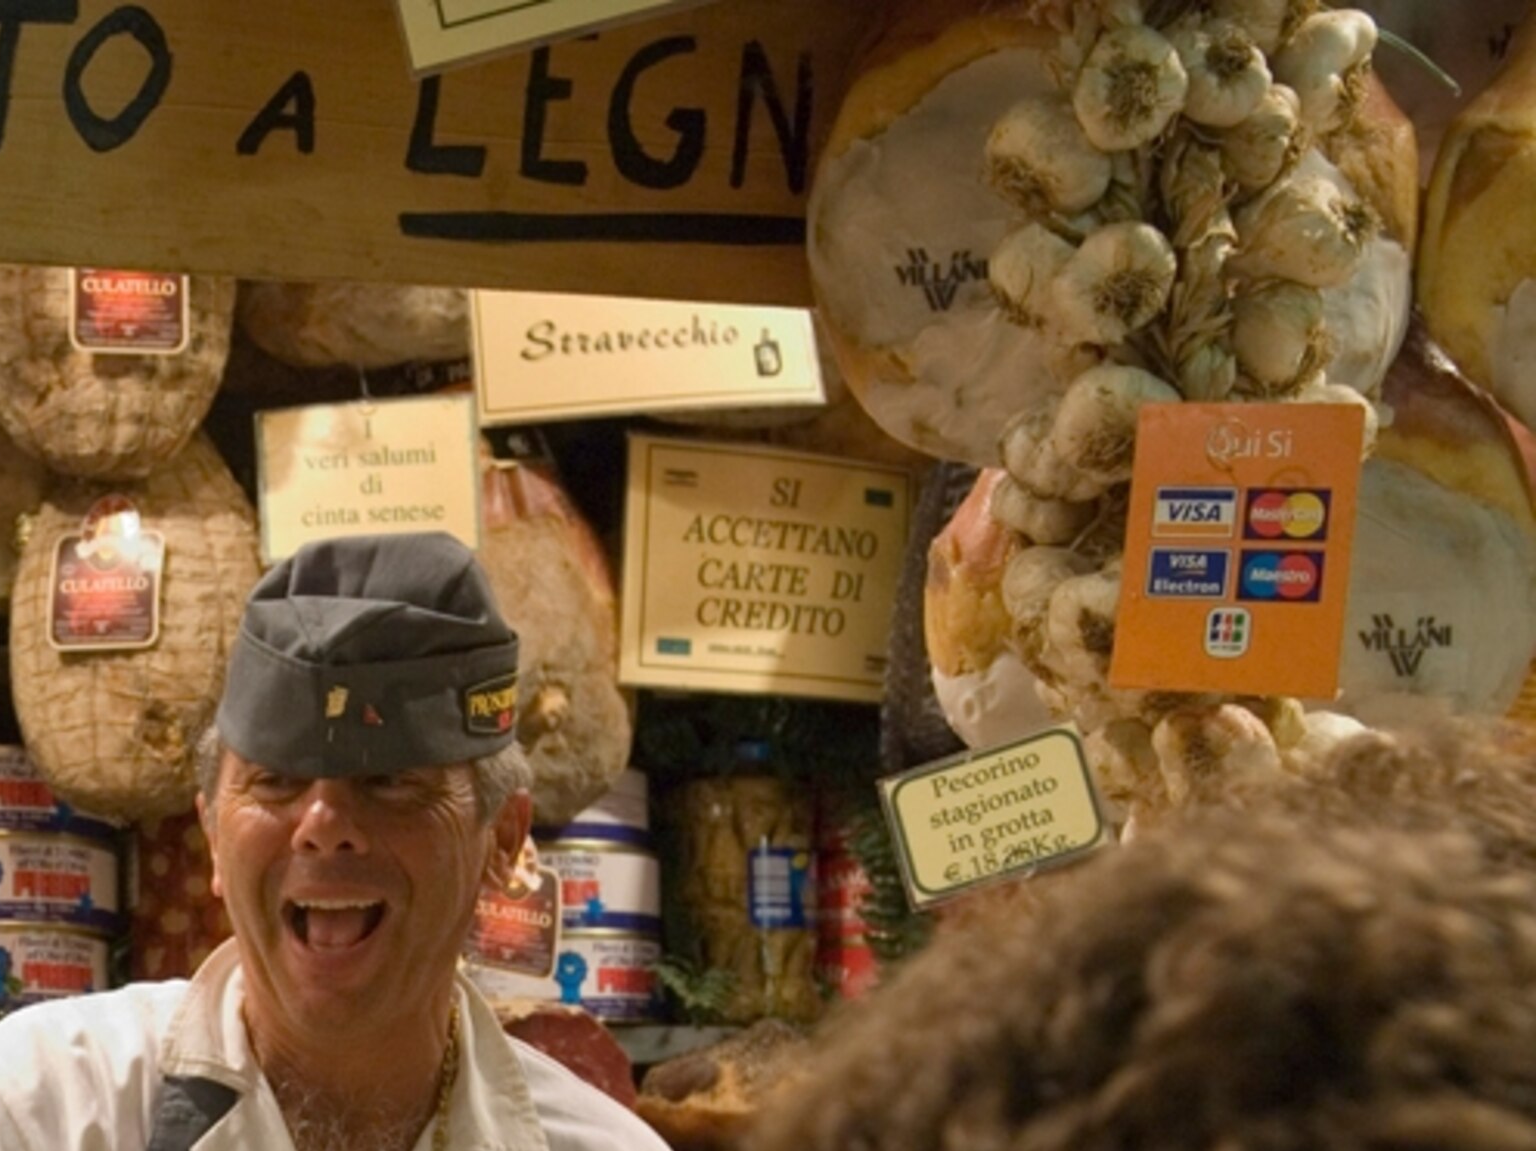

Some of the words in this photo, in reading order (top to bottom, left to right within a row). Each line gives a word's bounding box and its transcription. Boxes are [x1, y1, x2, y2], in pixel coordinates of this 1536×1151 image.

[520, 314, 739, 361] Stravecchio
[358, 443, 436, 467] salumi
[359, 472, 382, 495] di
[769, 478, 803, 508] SI
[301, 505, 360, 527] cinta
[367, 502, 445, 522] senese
[1168, 502, 1222, 523] VISA
[682, 514, 878, 561] ACCETTANO
[1169, 553, 1208, 570] VISA
[1250, 567, 1311, 584] Maestro
[697, 557, 809, 596] CARTE
[829, 570, 864, 602] DI
[1153, 579, 1221, 594] Electron
[696, 597, 845, 638] CREDITO
[931, 752, 1041, 798] Pecorino
[929, 776, 1060, 829] stagionato
[947, 831, 975, 853] in
[979, 808, 1055, 850] grotta
